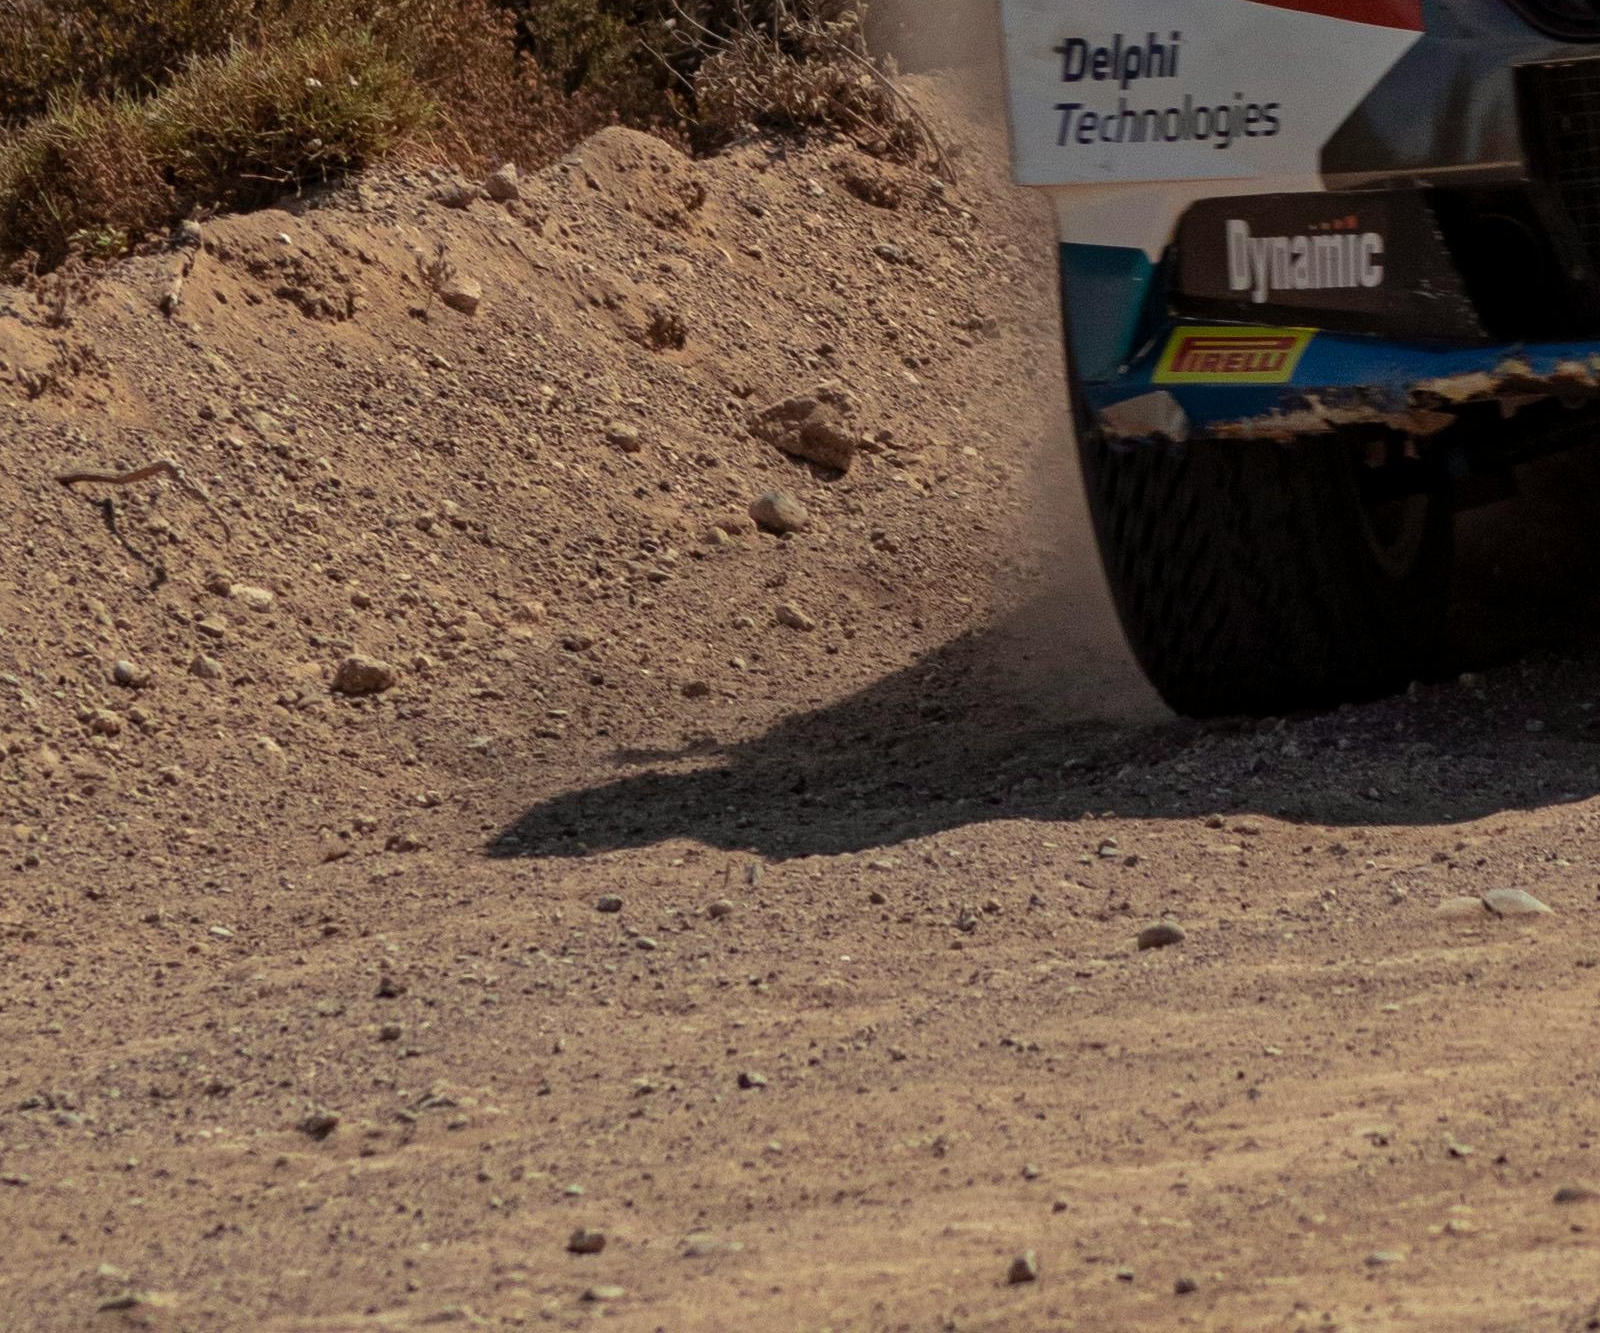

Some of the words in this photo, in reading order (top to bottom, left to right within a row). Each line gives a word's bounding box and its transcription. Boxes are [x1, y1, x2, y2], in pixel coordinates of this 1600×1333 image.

[1060, 30, 1182, 90] Delphi
[1054, 91, 1280, 149] Technologies
[1225, 219, 1385, 304] Dynamic
[1169, 336, 1300, 373] PIRELLI
